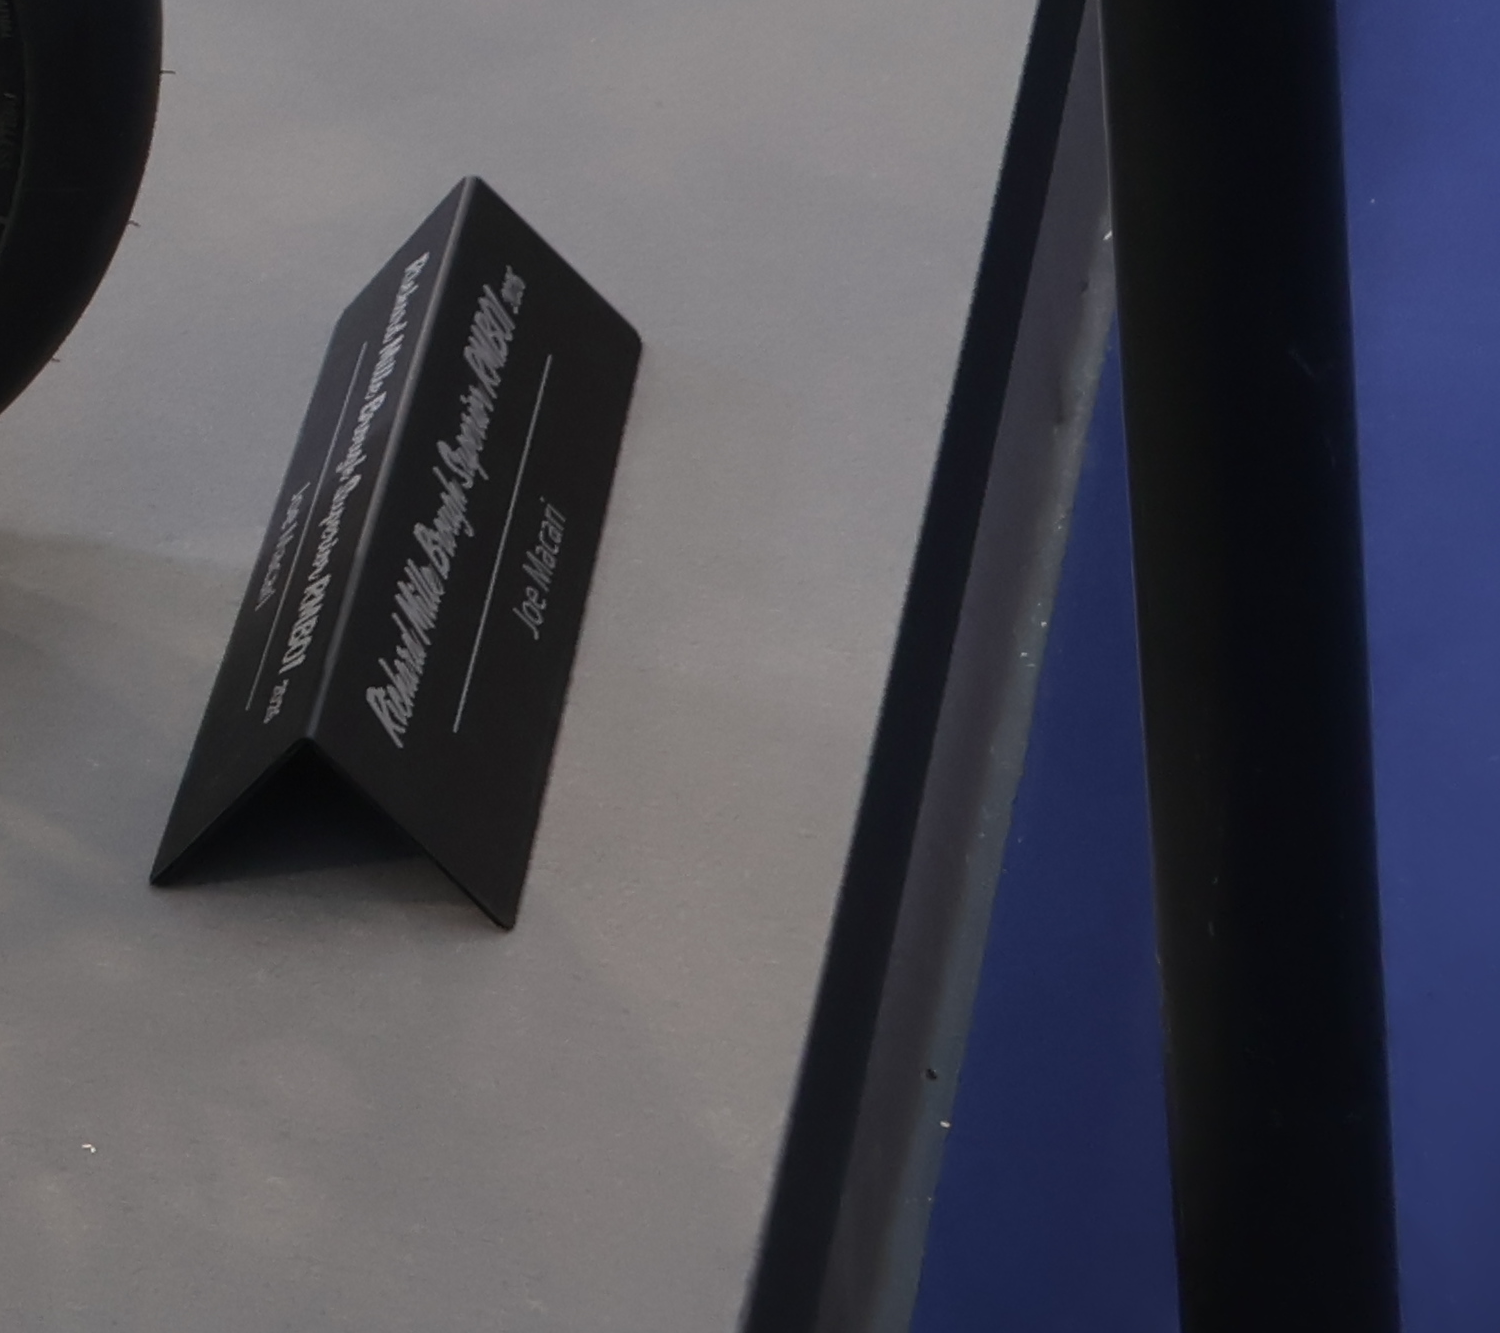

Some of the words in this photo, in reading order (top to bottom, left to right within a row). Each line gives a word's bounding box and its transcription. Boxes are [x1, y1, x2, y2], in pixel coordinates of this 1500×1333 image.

[463, 283, 515, 391] RMB01
[438, 383, 497, 481] Superior
[414, 466, 473, 565] Brough
[522, 496, 566, 594] Macari
[393, 553, 444, 647] Mille
[511, 574, 548, 642] Joe
[364, 612, 426, 749] Richard
